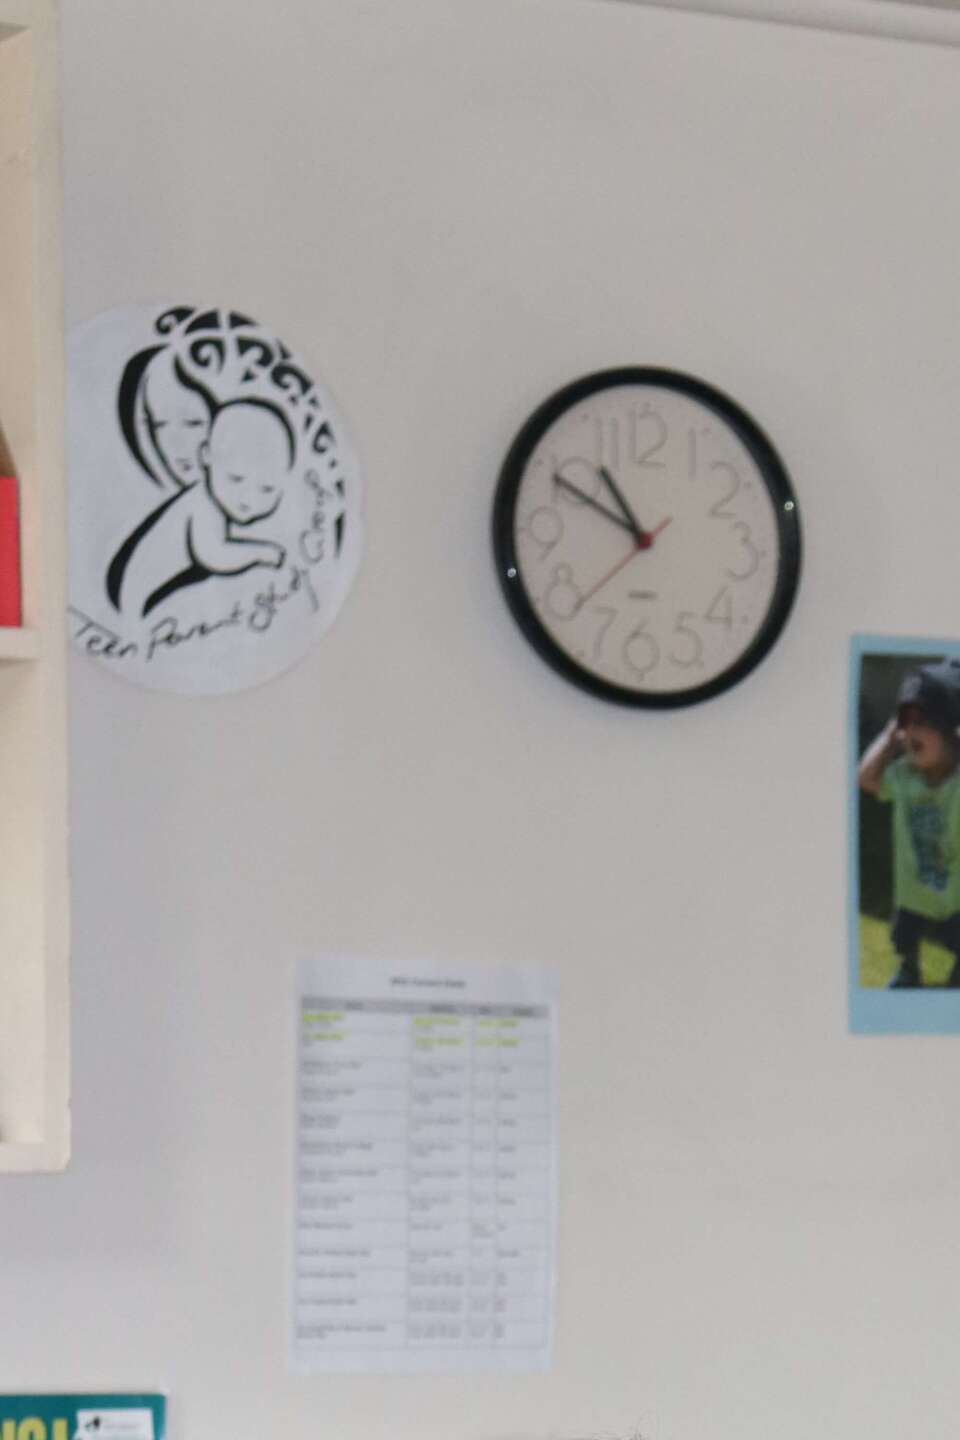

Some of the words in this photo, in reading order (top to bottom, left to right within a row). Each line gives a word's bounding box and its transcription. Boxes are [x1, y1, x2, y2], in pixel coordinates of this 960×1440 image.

[596, 417, 620, 472] 11
[629, 405, 668, 469] 12
[687, 427, 697, 482] 1
[552, 454, 601, 505] 10
[707, 460, 741, 519] 2
[527, 505, 565, 561] 9
[727, 521, 759, 581] 3
[543, 562, 585, 622] 8
[703, 585, 735, 631] 4
[68, 604, 138, 656] Teen
[146, 601, 242, 661] Parent
[590, 606, 619, 657] 7
[622, 621, 660, 673] 6
[669, 611, 703, 668] 5
